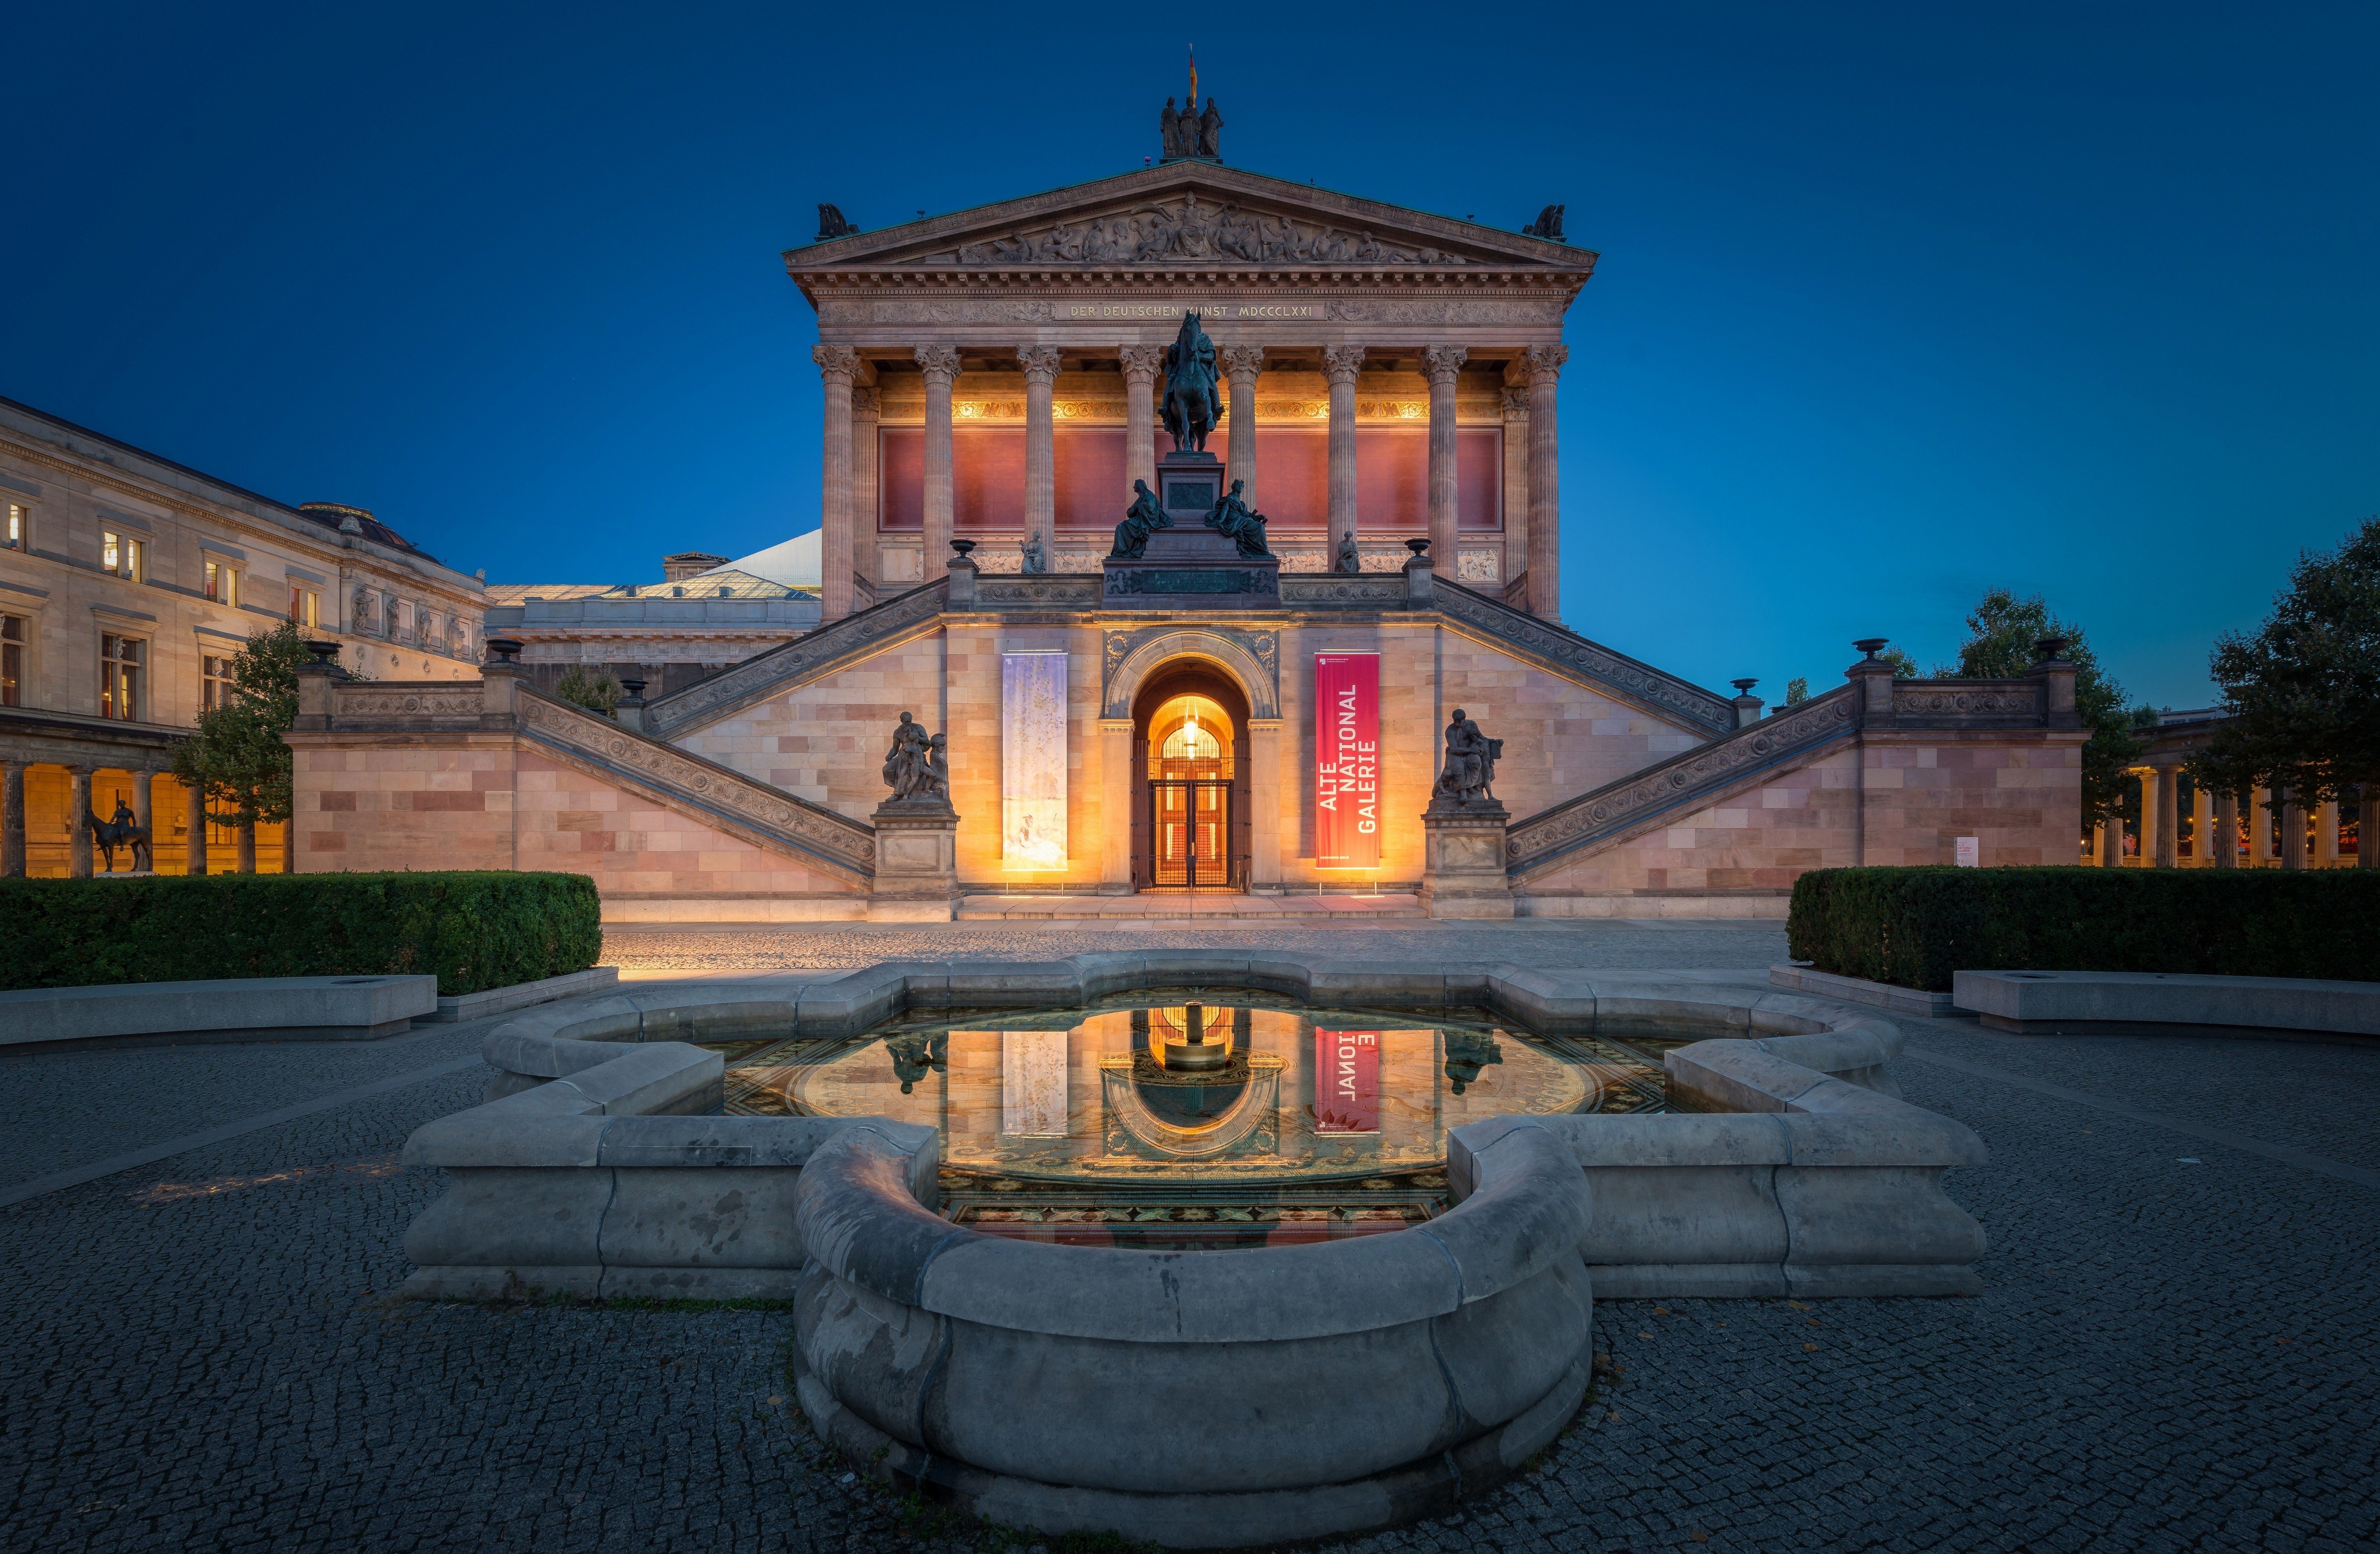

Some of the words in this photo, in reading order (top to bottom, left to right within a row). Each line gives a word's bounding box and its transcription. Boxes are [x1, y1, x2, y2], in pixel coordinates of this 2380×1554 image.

[1070, 307, 1096, 316] DER
[1103, 307, 1179, 316] DEUTSCHEN
[1186, 307, 1228, 316] KUNST
[1238, 307, 1312, 316] MDCCCLXXI
[1339, 685, 1356, 792] NATIONAL
[1320, 762, 1337, 811] ALTE
[1358, 741, 1375, 833] GALERIE
